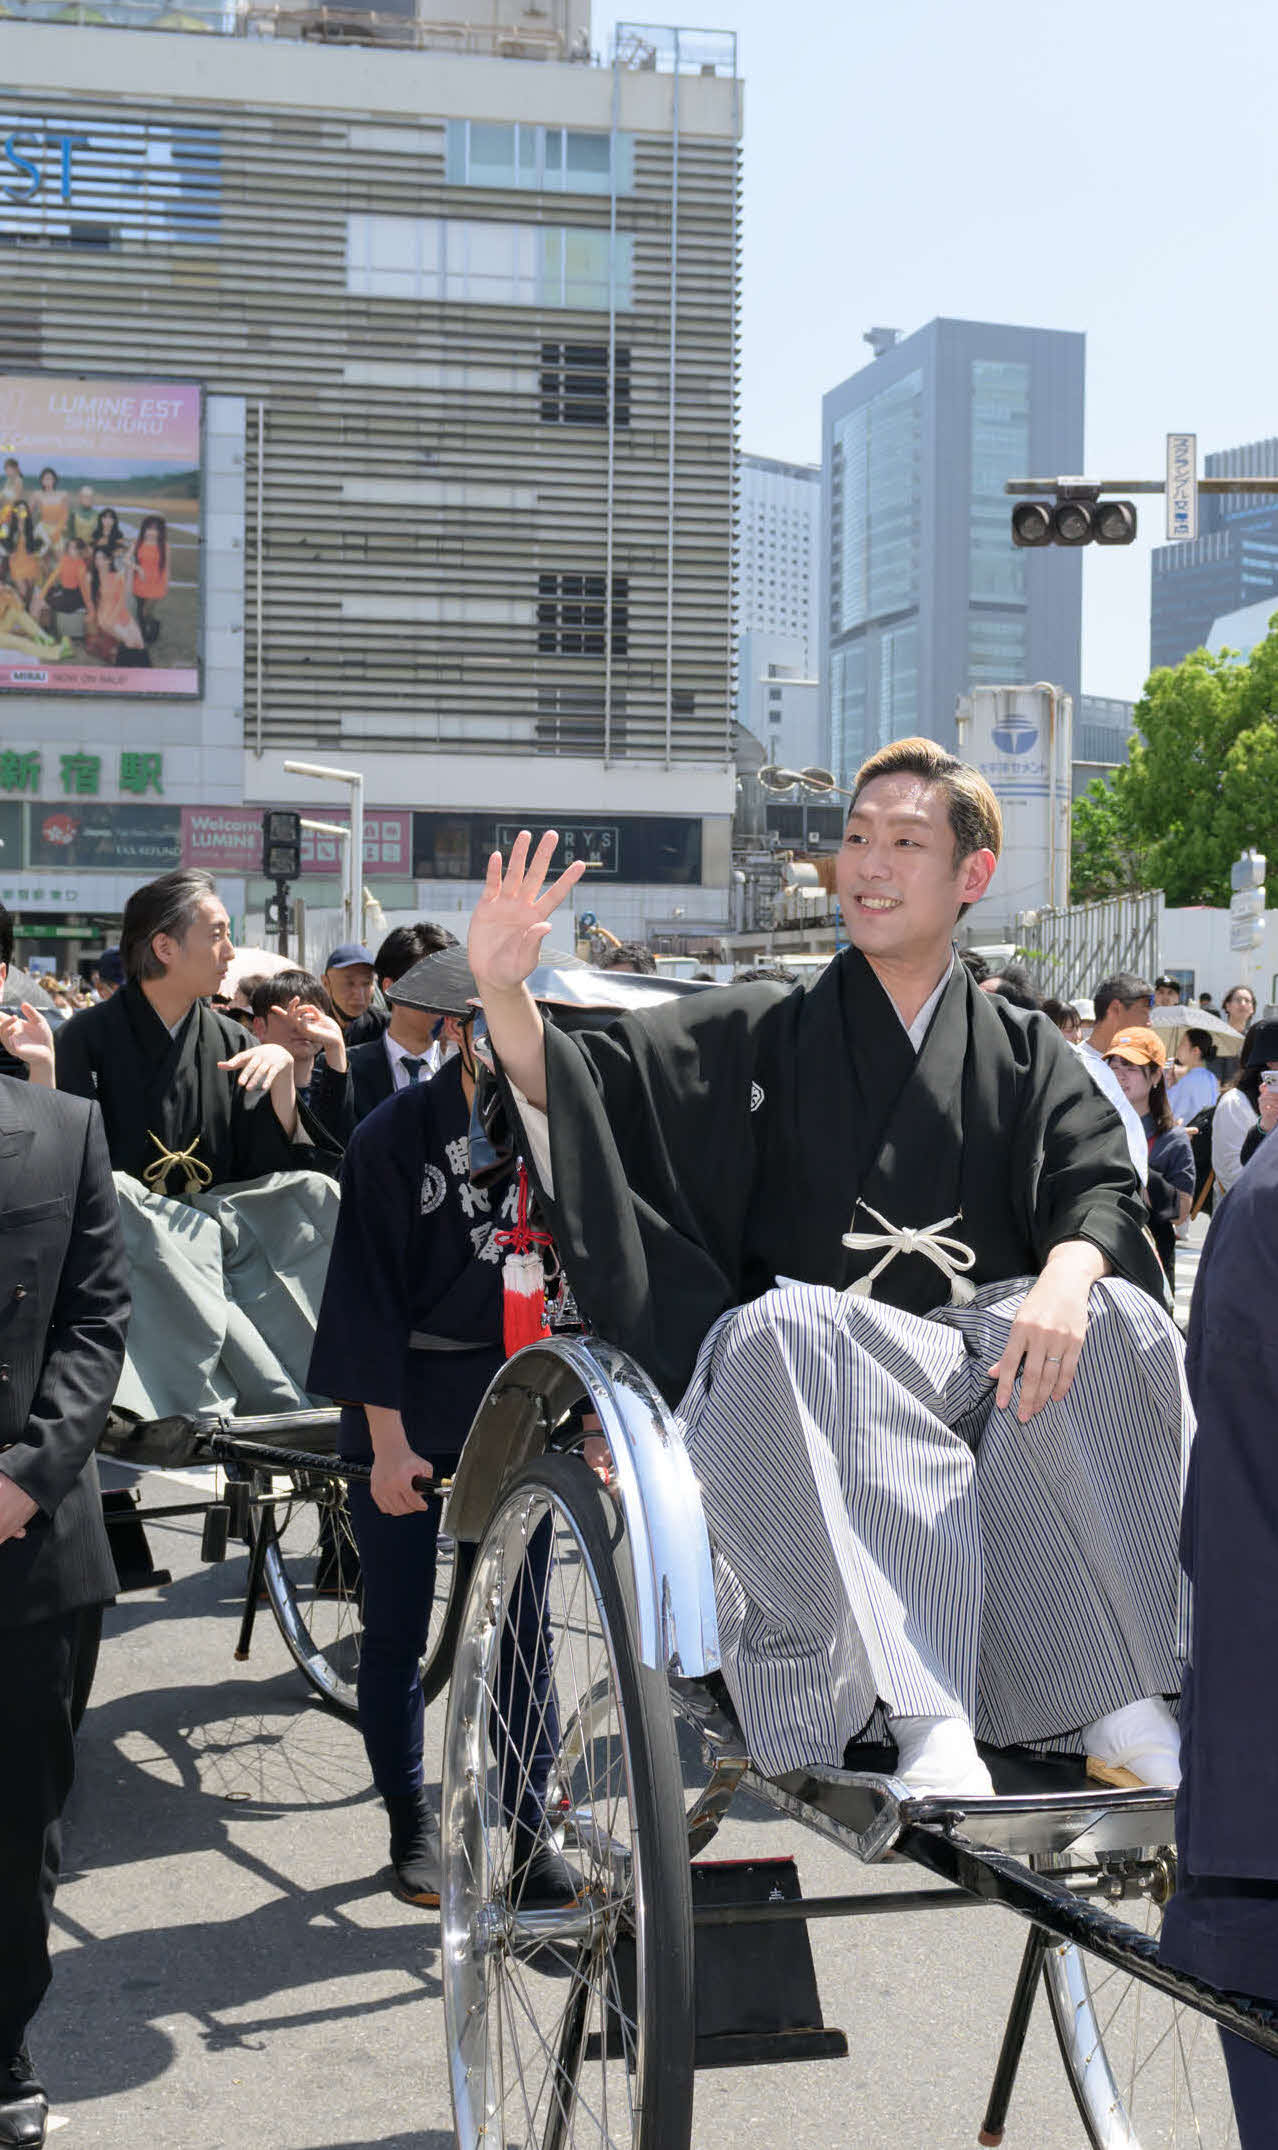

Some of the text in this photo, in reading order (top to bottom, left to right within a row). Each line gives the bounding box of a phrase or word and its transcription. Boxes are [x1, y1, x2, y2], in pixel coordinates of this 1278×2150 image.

[49, 393, 136, 417] LUMINE
[140, 399, 184, 418] EST
[0, 750, 164, 795] 新宿駅
[192, 832, 255, 849] LUMINE
